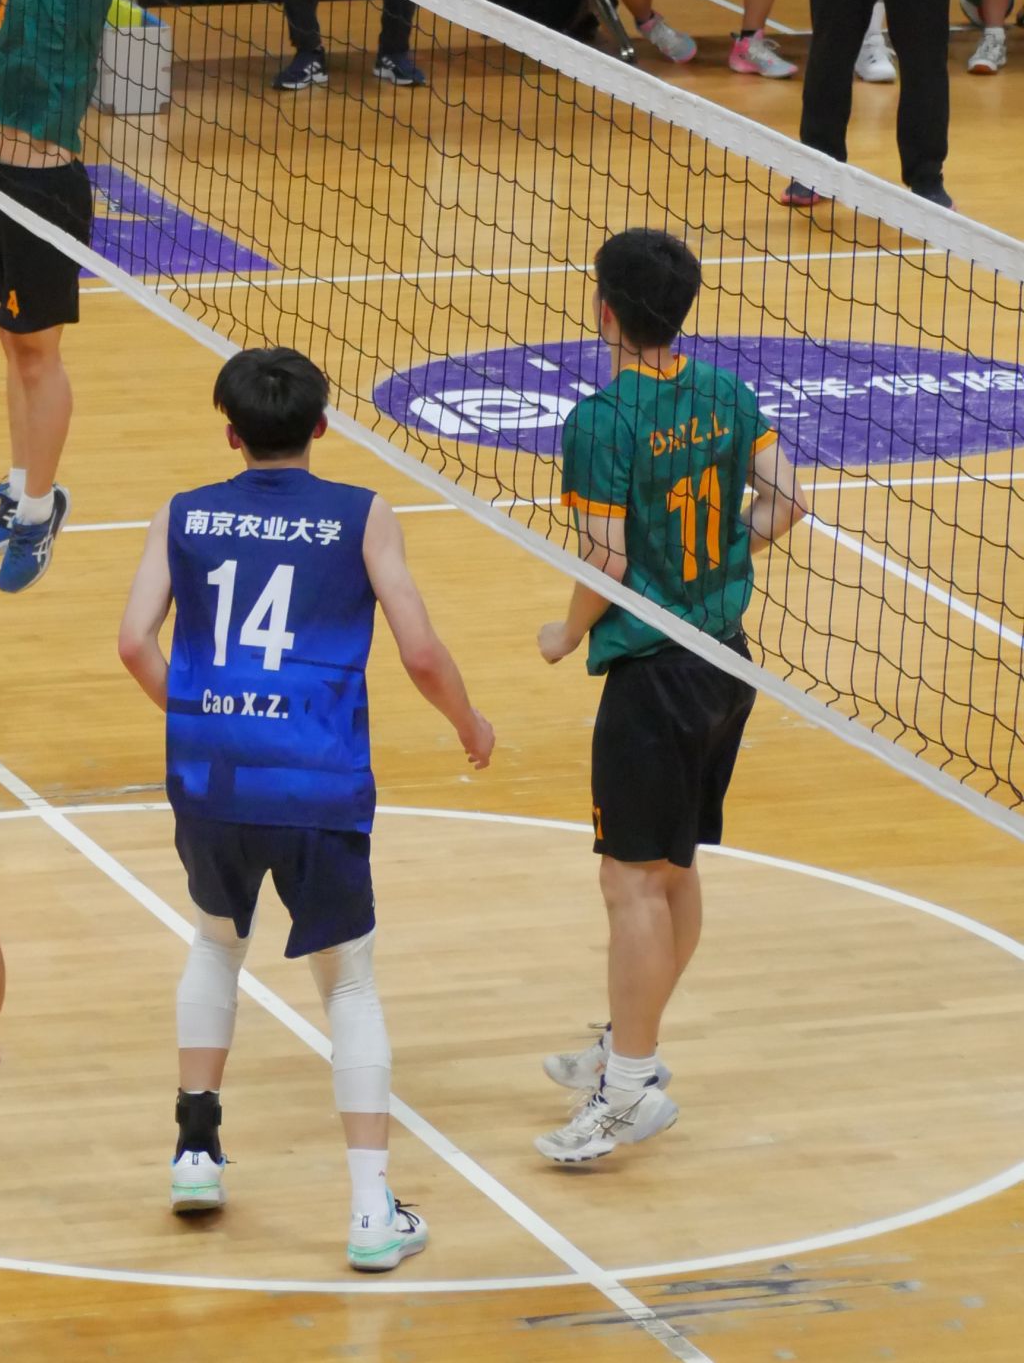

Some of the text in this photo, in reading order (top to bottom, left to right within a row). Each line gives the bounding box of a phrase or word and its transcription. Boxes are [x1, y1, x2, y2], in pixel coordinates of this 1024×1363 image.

[185, 509, 342, 546] 南京农业大学
[666, 464, 721, 583] 11
[207, 559, 295, 671] 14
[202, 688, 289, 719] Cao X.Z.
